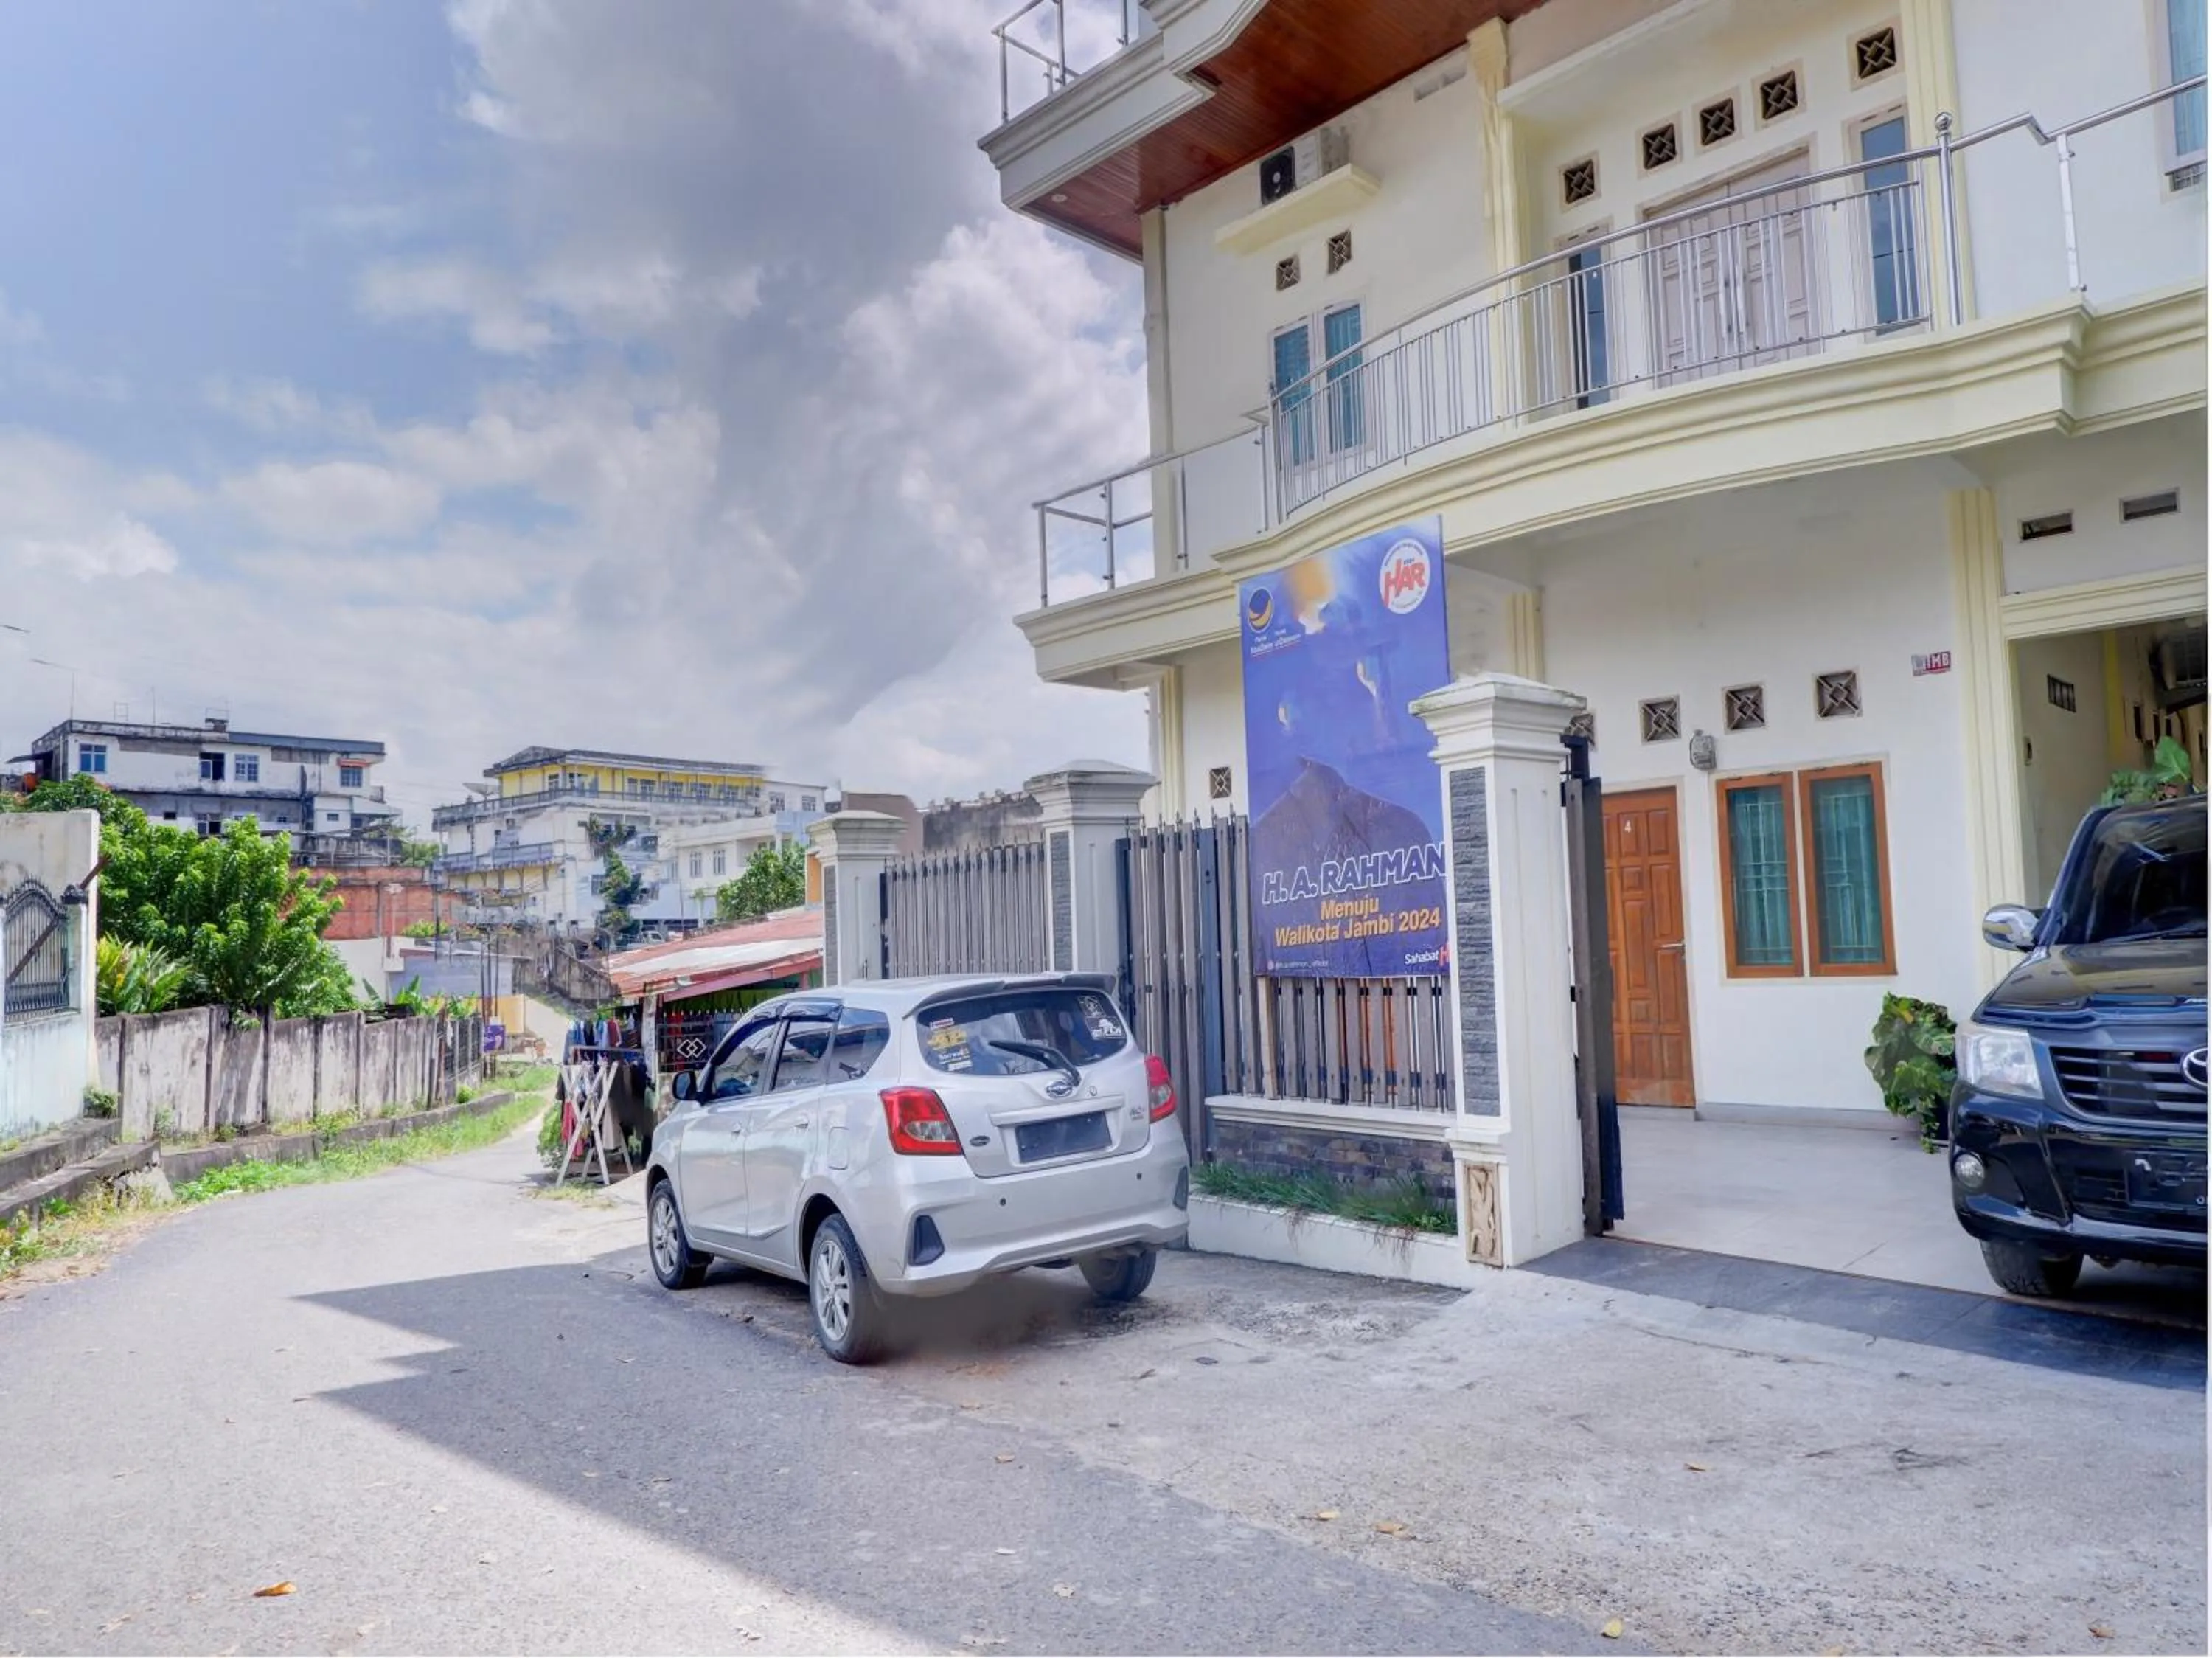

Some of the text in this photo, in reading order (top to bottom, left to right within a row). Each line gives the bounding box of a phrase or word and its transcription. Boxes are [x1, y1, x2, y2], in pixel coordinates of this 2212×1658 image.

[1384, 558, 1426, 608] HAR
[1321, 897, 1379, 920] Menuju
[1275, 907, 1439, 947] Walikota Jambi 2024
[1405, 950, 1439, 965] Sahabat
